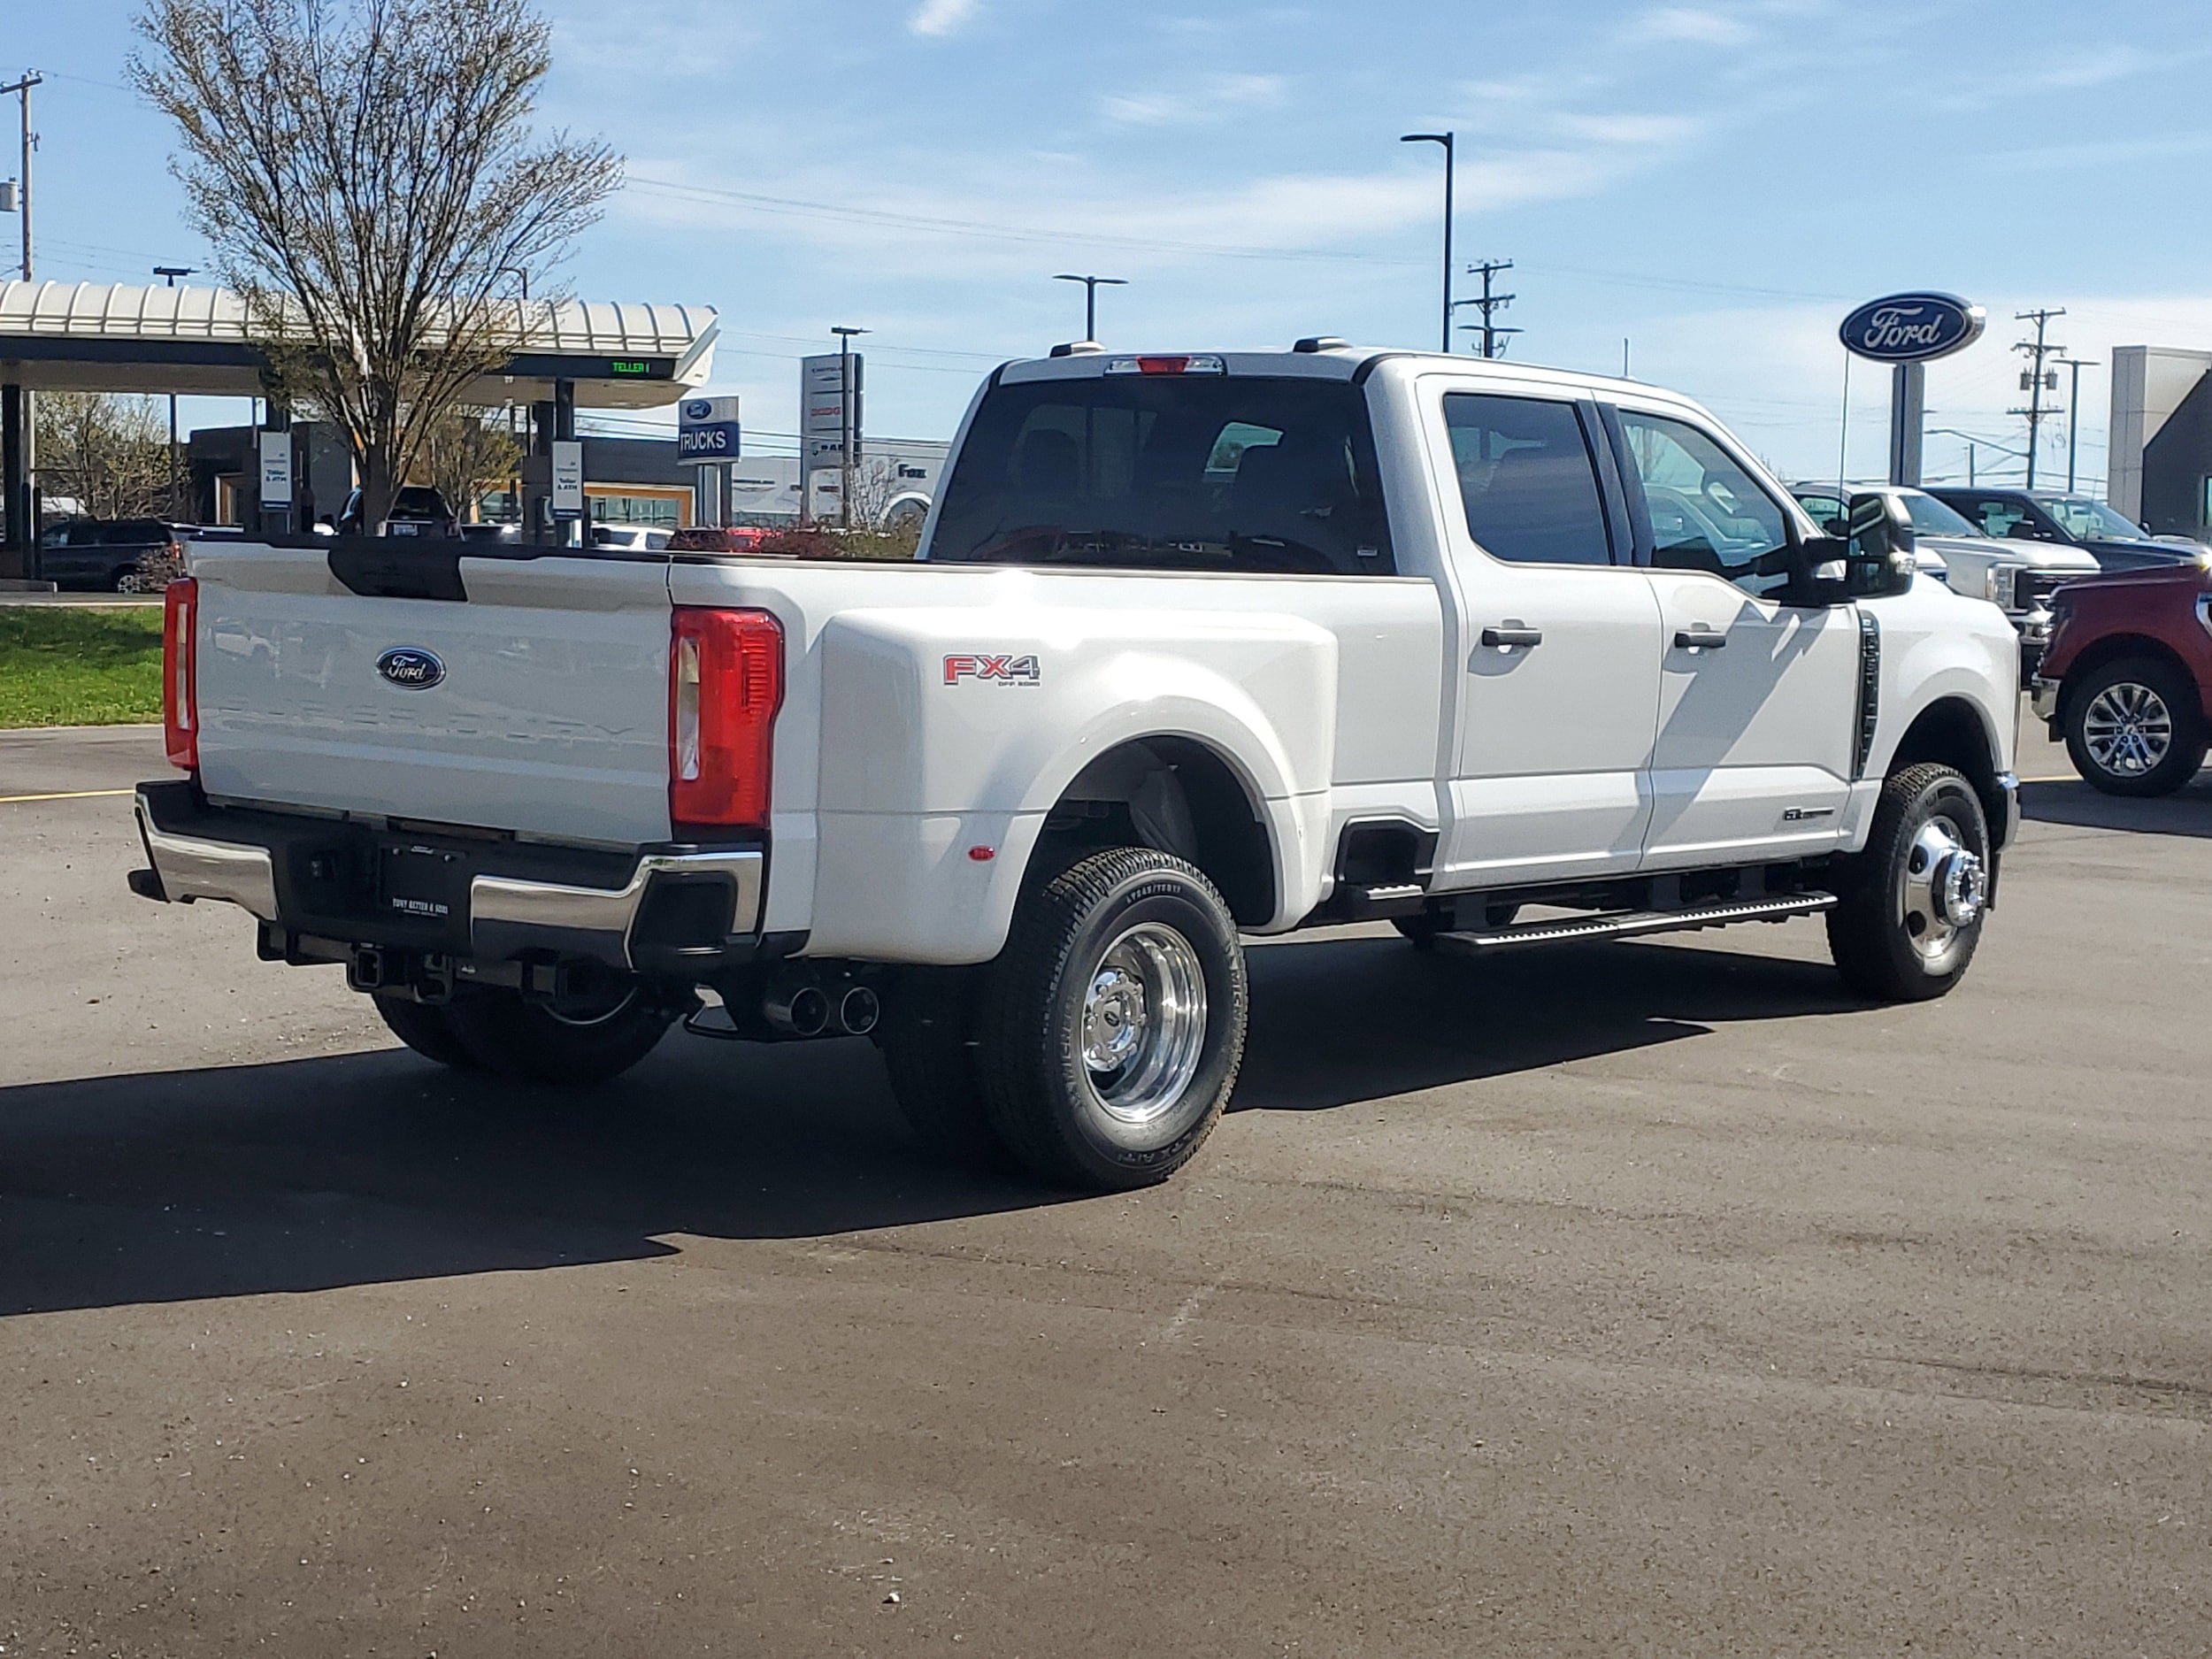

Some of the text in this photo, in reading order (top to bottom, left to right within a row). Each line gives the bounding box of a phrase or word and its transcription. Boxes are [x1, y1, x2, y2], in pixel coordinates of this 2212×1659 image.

[1864, 306, 1945, 349] Ford
[613, 361, 644, 373] TELLER
[680, 430, 726, 450] TRUCKS
[388, 655, 426, 680] Ford
[943, 654, 1041, 686] FX4
